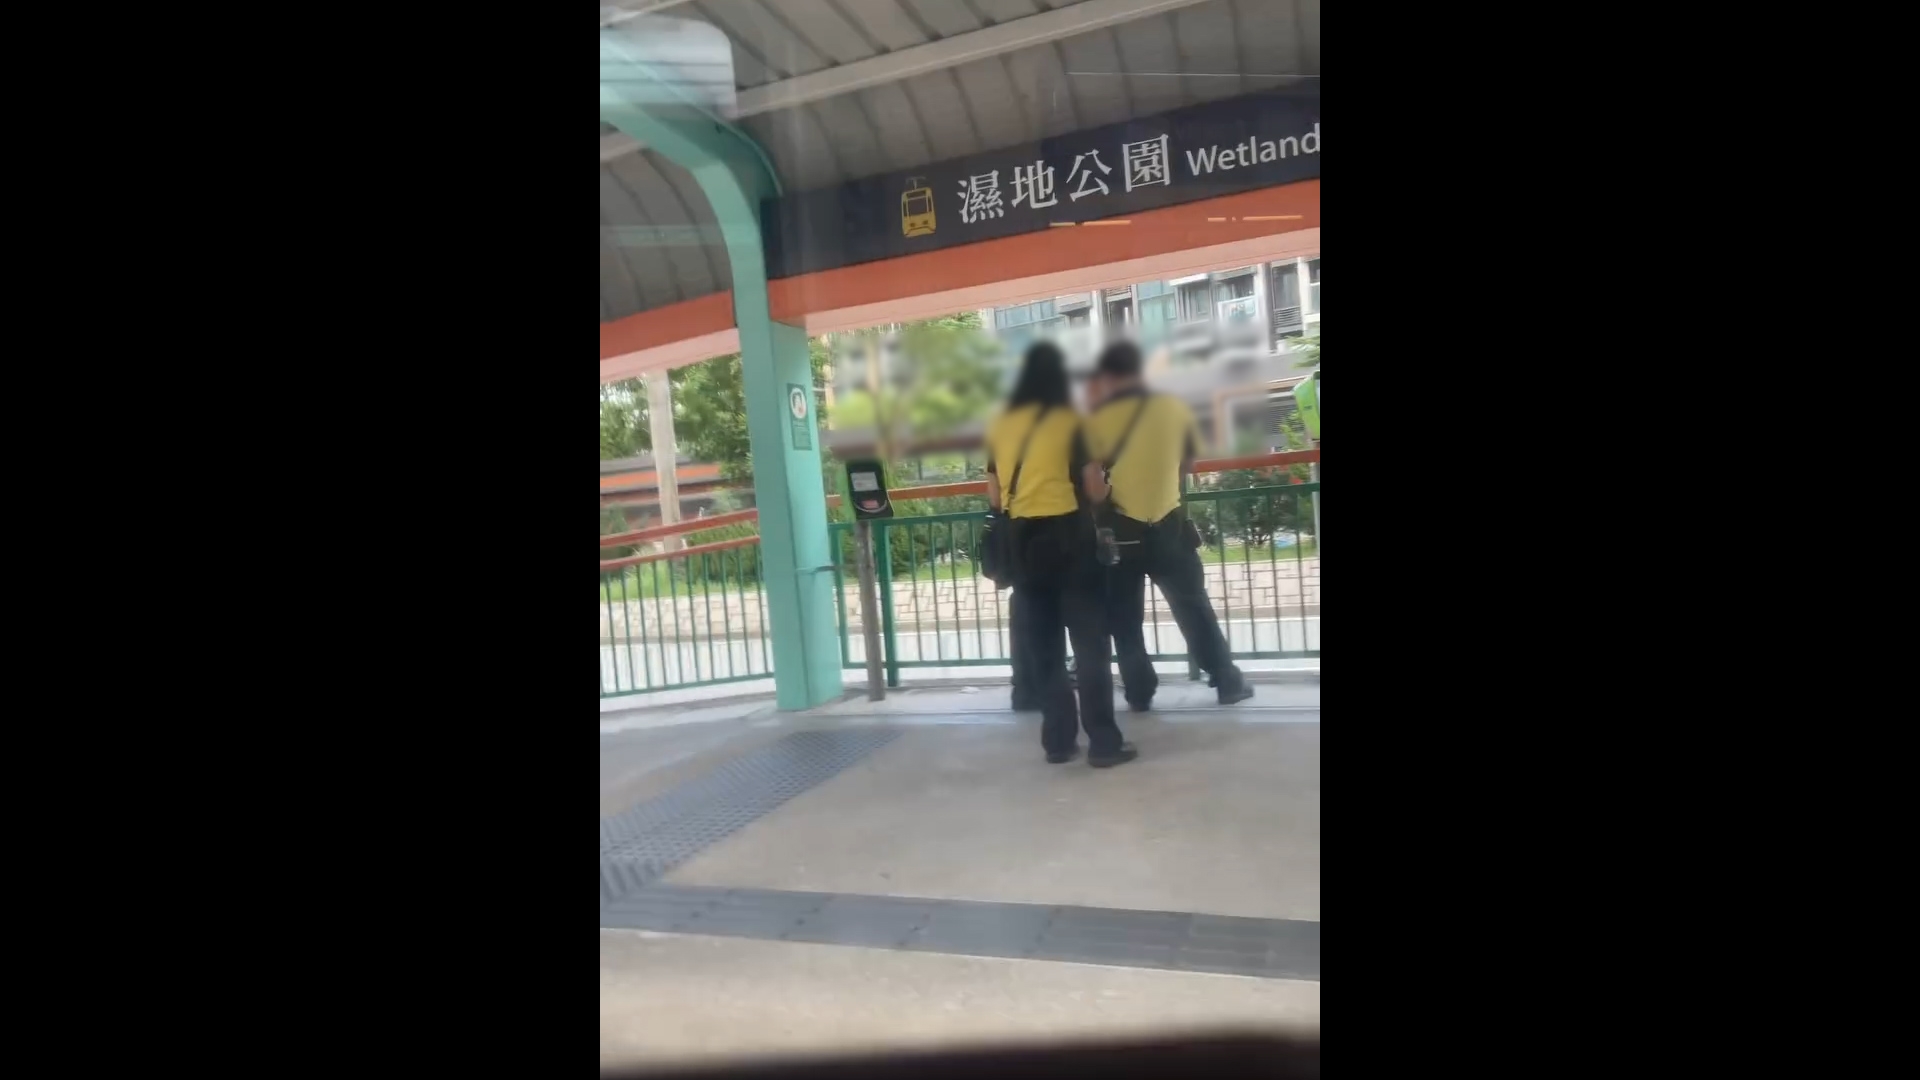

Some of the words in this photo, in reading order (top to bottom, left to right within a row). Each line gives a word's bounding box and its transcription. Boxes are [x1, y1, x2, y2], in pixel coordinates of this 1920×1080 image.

[957, 134, 1172, 223] 濕地公園
[1186, 123, 1320, 176] Wetland
